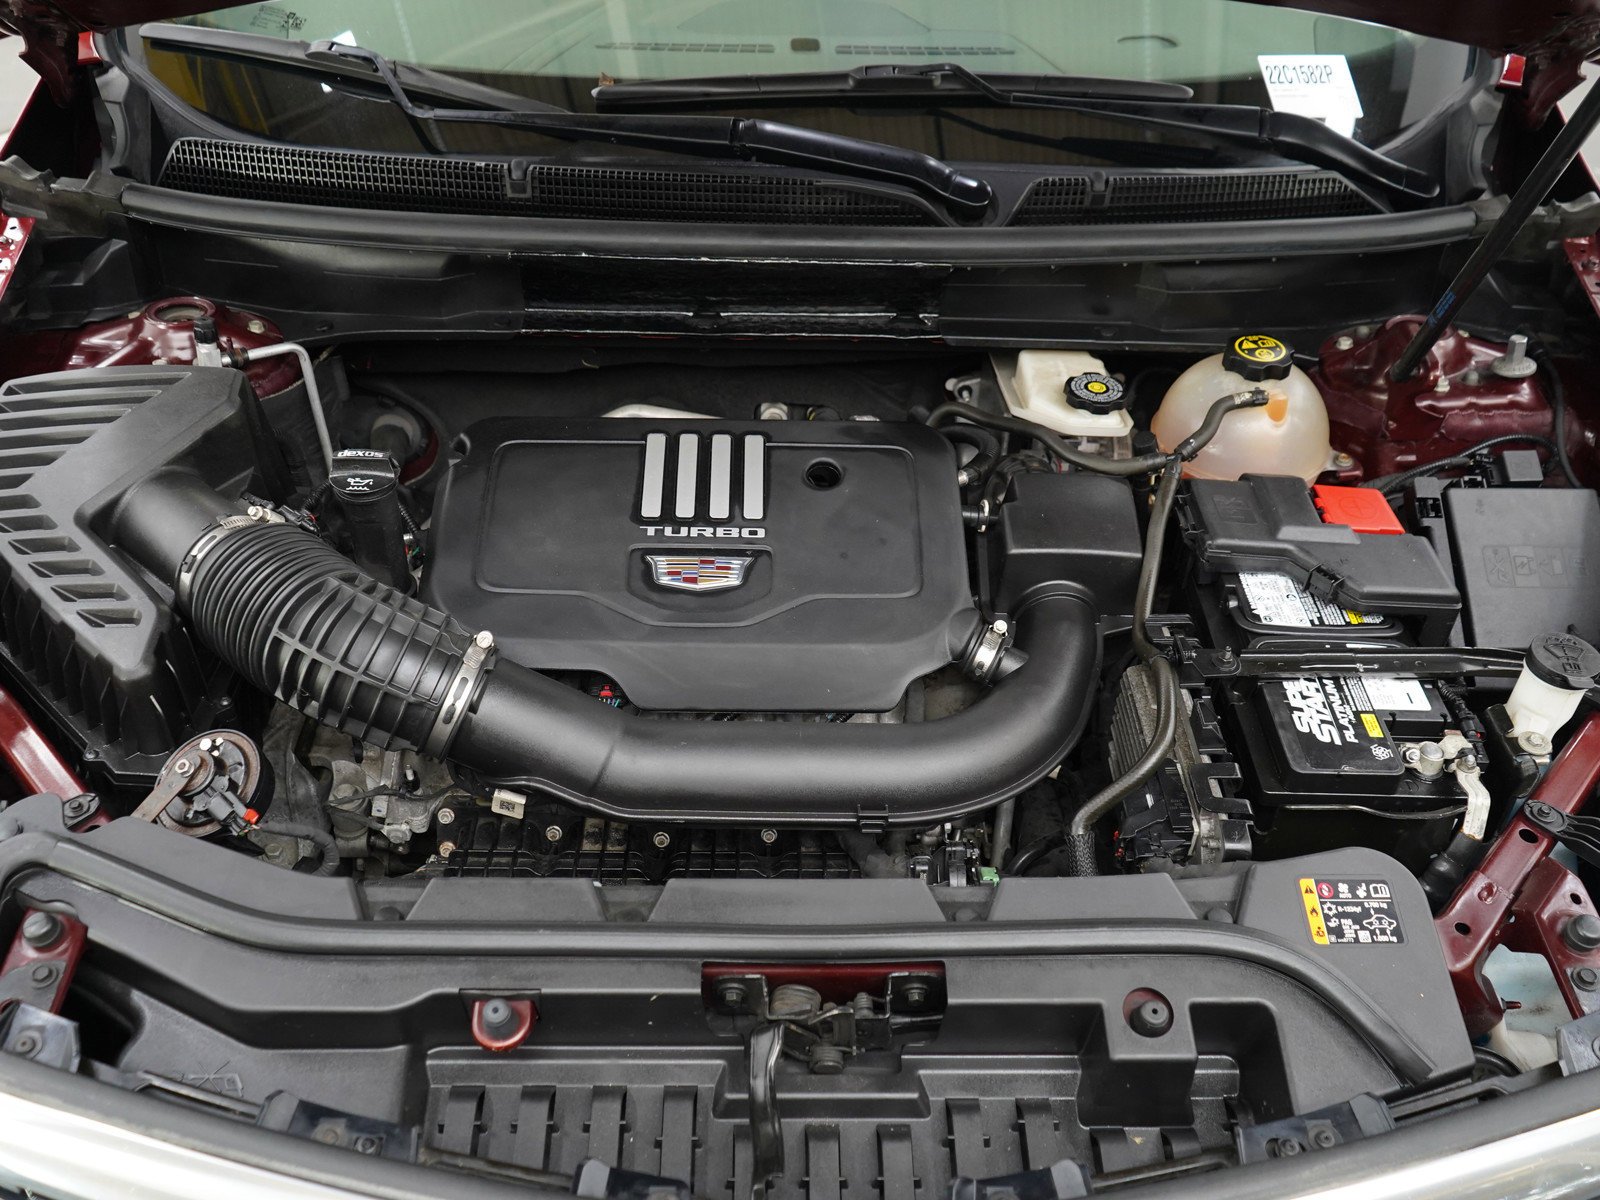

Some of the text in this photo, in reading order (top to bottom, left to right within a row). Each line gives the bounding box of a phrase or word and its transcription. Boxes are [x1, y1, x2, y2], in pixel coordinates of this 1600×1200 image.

[1265, 65, 1333, 84] 22C1582P
[337, 449, 385, 458] dexos
[640, 526, 766, 538] TURBO
[1283, 681, 1310, 733] SUPE
[1300, 677, 1342, 746] STAR
[1322, 679, 1359, 743] PLATINUM
